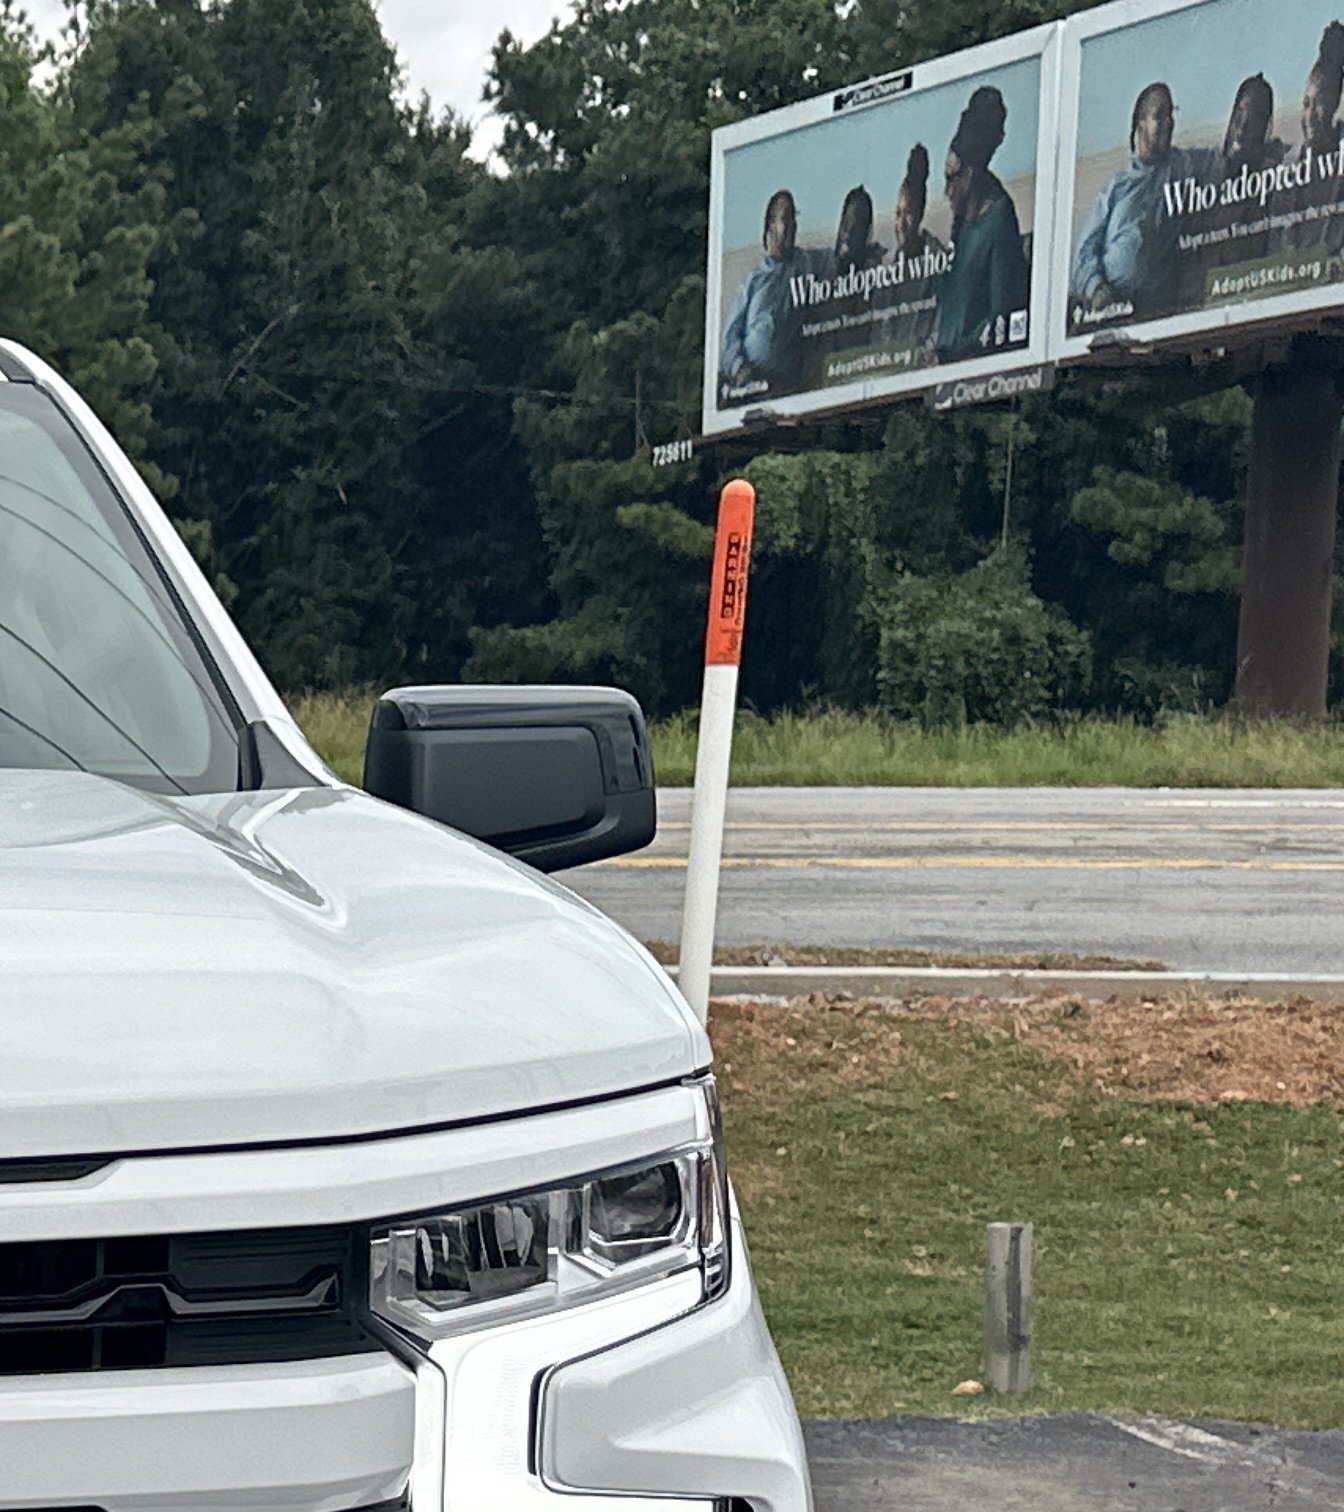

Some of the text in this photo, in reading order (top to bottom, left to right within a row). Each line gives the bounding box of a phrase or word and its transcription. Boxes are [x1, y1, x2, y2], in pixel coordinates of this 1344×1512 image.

[1163, 175, 1216, 217] Who
[1219, 146, 1312, 207] adopted
[789, 241, 955, 308] Who adopted who?
[1210, 260, 1322, 296] AdoptUSKids.org
